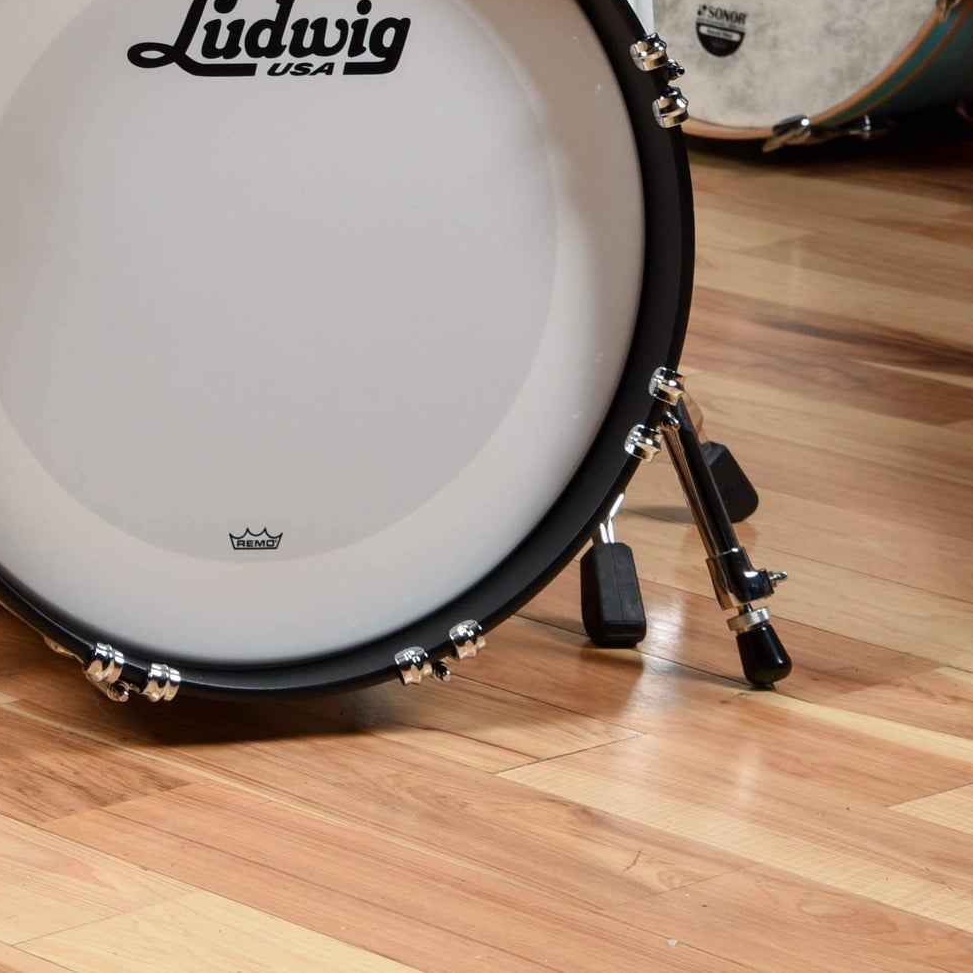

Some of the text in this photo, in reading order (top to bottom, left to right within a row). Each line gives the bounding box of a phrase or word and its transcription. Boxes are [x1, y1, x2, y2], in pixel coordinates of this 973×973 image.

[707, 5, 747, 26] SONOR
[266, 62, 335, 77] USA
[236, 539, 275, 548] REMO
